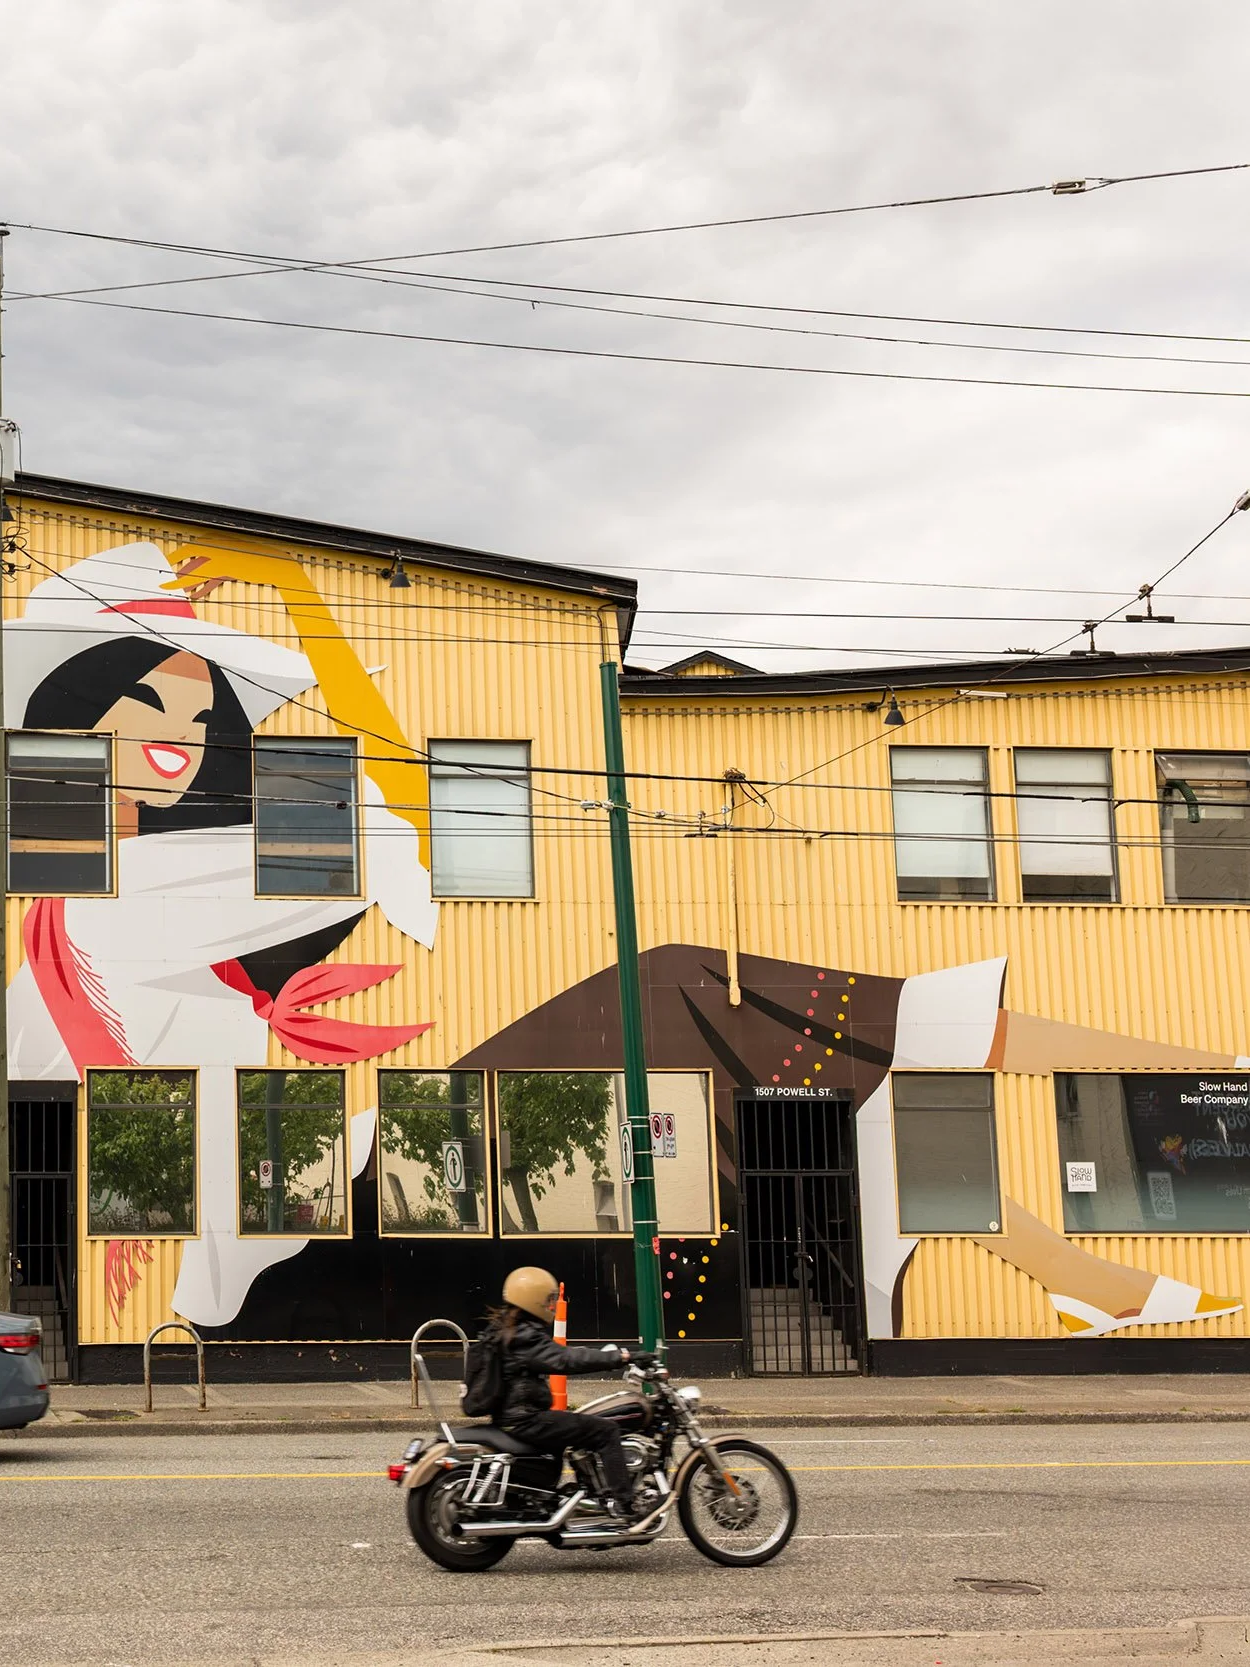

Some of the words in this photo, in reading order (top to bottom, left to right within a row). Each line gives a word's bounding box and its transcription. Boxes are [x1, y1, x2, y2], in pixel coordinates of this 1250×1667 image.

[754, 1087, 775, 1096] 1507
[777, 1087, 817, 1097] POWELL
[818, 1087, 833, 1097] ST.
[1198, 1081, 1221, 1092] Slow
[1223, 1081, 1248, 1092] Hand
[1180, 1094, 1202, 1104] Beer
[1204, 1094, 1249, 1106] Company
